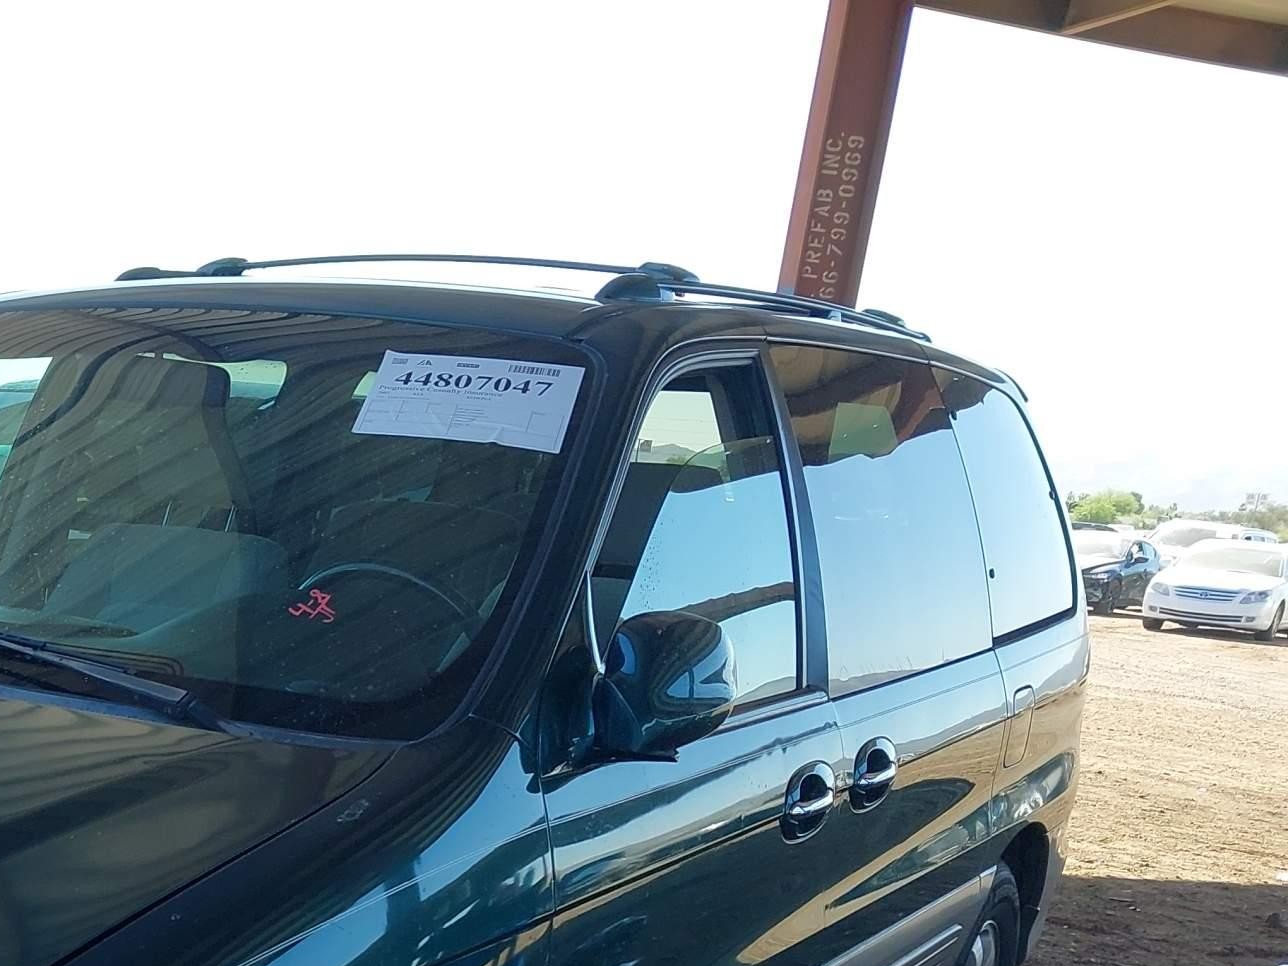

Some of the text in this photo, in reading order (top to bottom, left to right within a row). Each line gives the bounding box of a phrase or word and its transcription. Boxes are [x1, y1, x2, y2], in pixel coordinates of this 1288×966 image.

[802, 133, 845, 279] PREFAB INC.
[395, 370, 554, 397] 44807047
